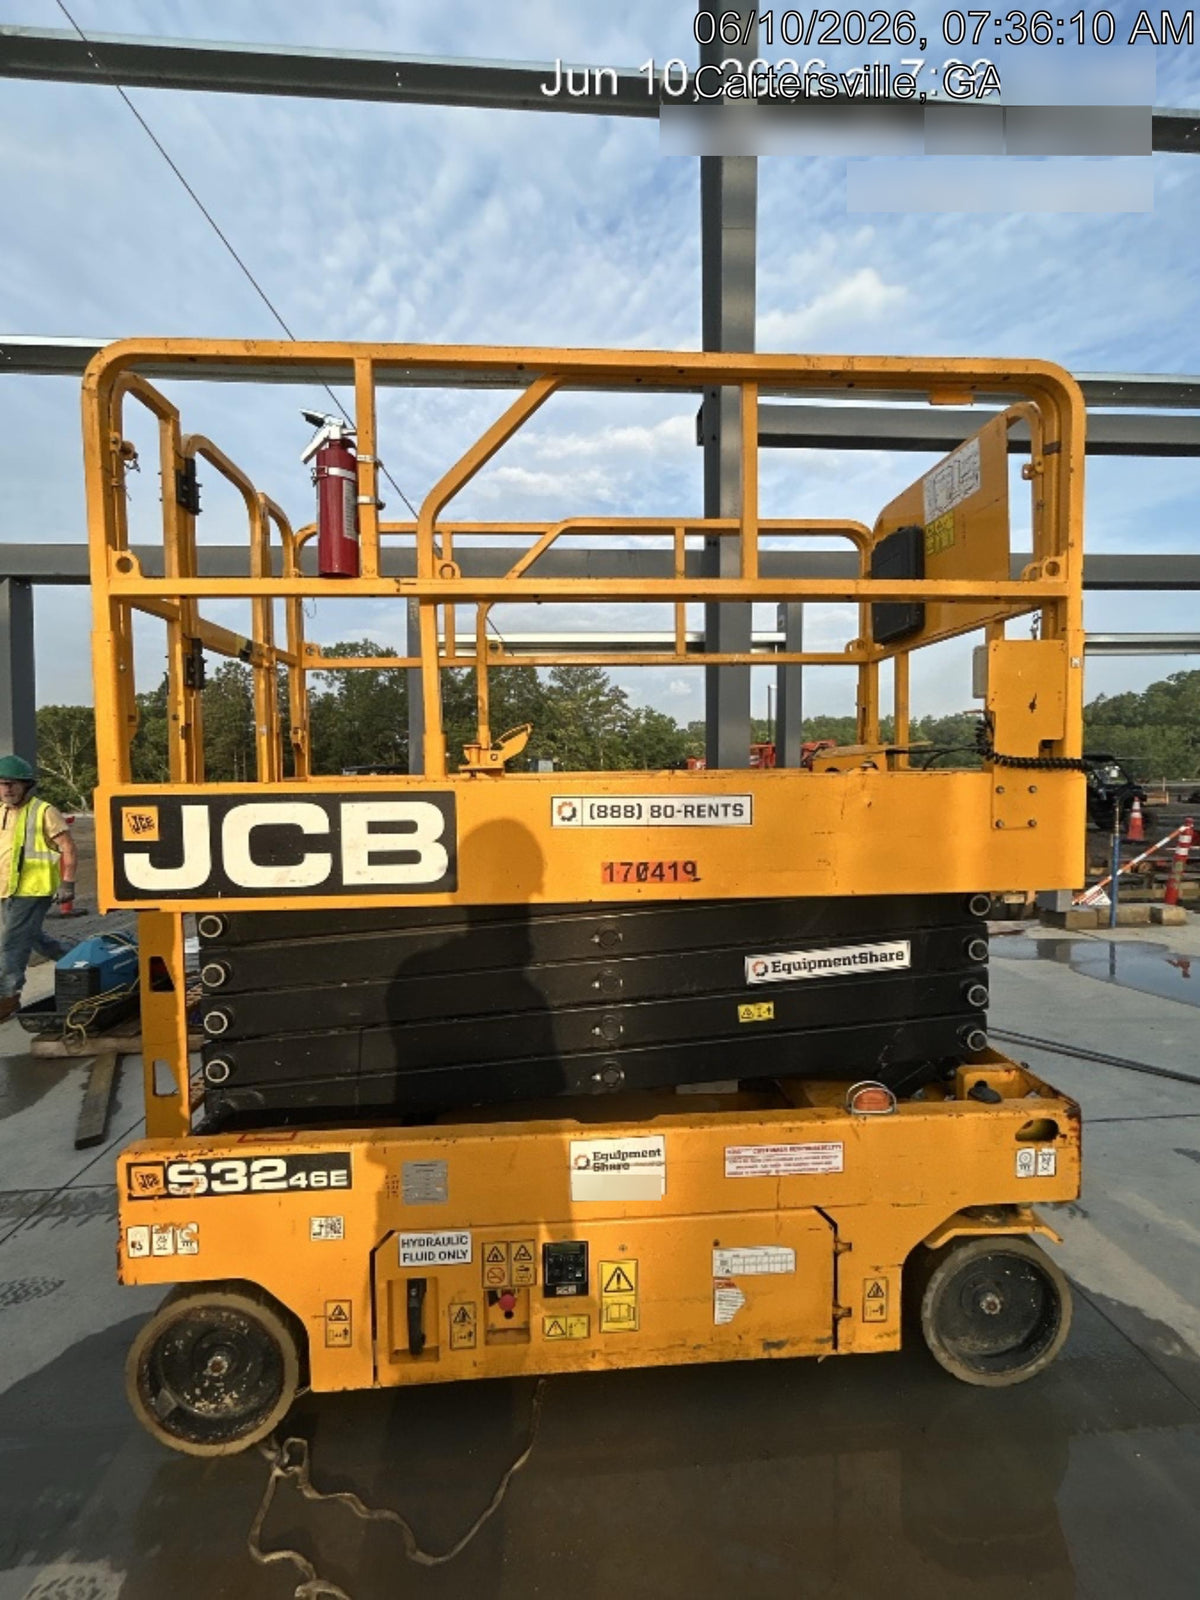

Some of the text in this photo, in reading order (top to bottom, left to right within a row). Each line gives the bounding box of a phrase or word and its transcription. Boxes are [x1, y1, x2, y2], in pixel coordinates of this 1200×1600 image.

[589, 803, 644, 820] (888)
[123, 800, 449, 890] JCB
[604, 860, 702, 882] 170419
[771, 949, 905, 975] EquipmentShare
[592, 1148, 662, 1162] Equipment
[401, 1234, 469, 1249] HYDRAULIC
[402, 1249, 469, 1263] FLUID ONLY
